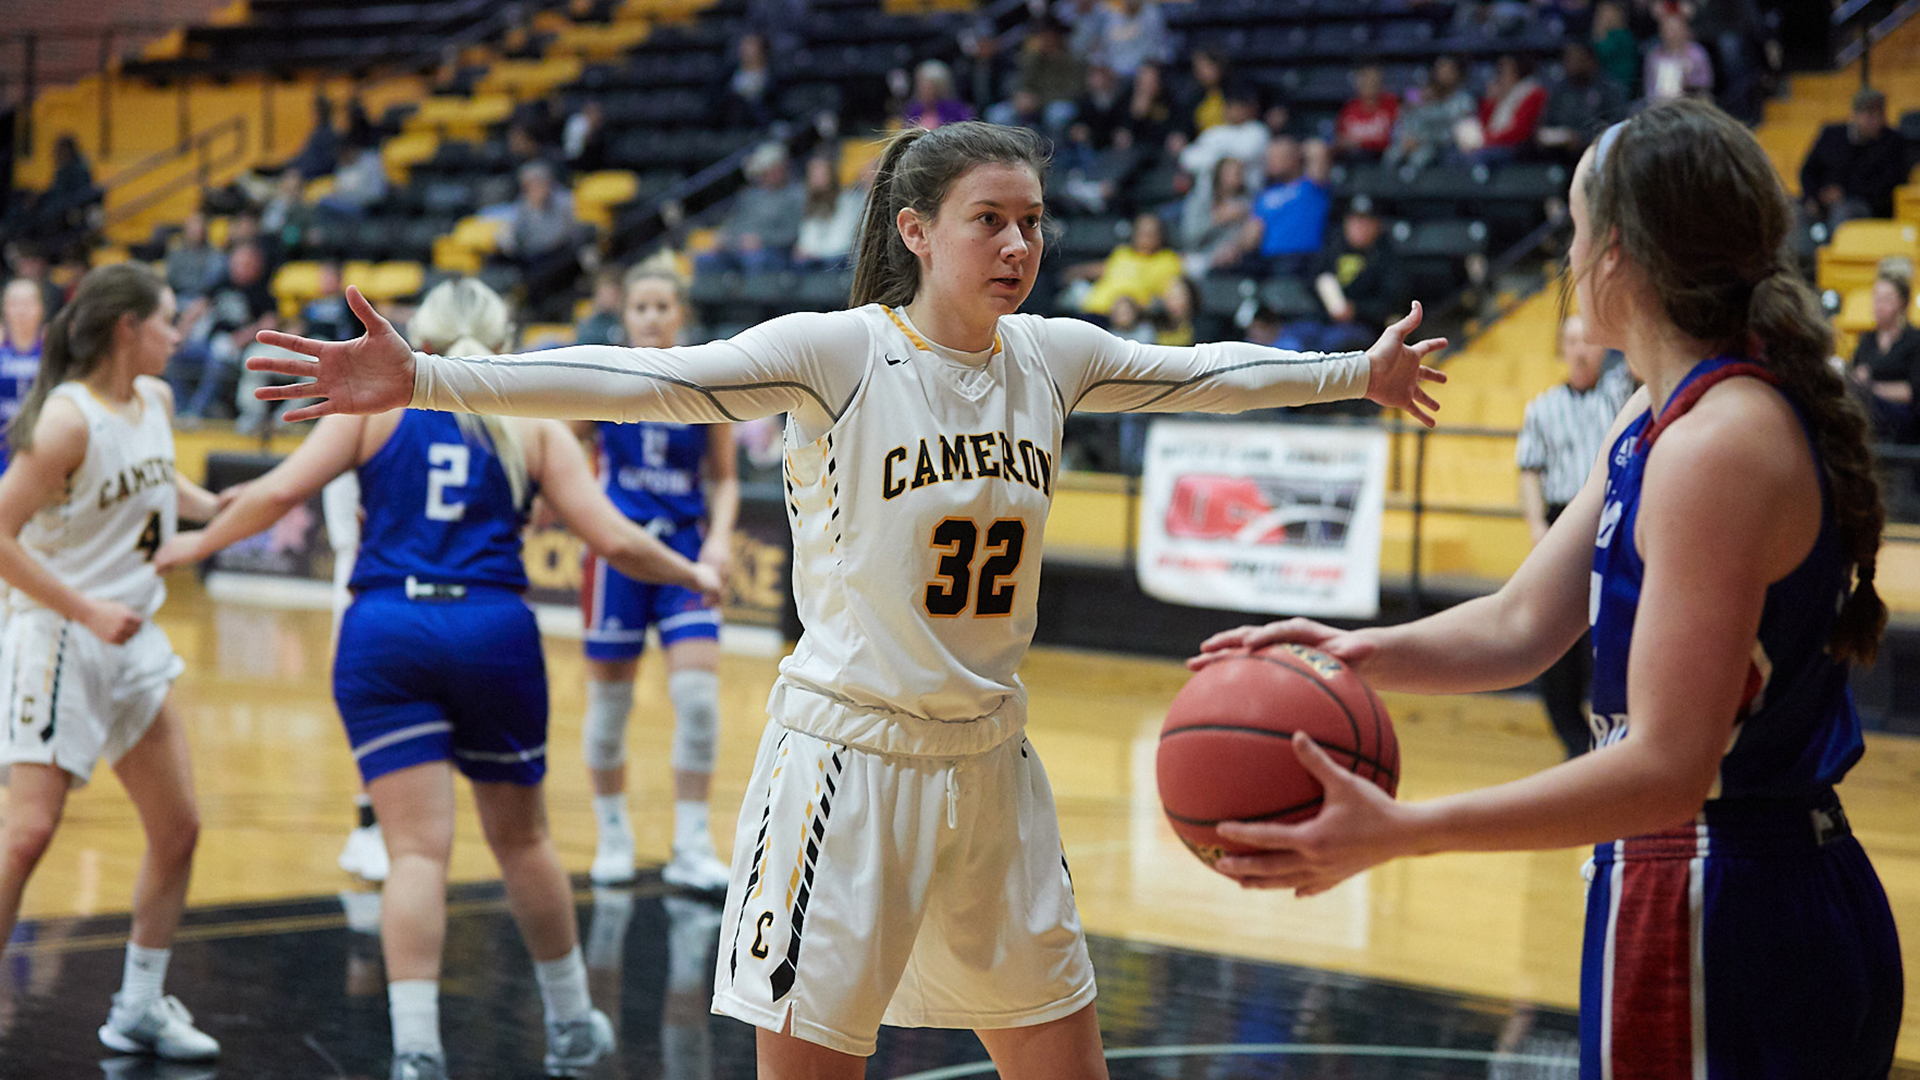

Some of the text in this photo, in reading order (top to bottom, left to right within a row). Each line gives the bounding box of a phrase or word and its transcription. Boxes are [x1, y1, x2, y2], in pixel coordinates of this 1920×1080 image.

[425, 442, 470, 521] 2
[134, 509, 161, 562] 4
[922, 515, 1027, 619] 32
[750, 910, 774, 961] C
